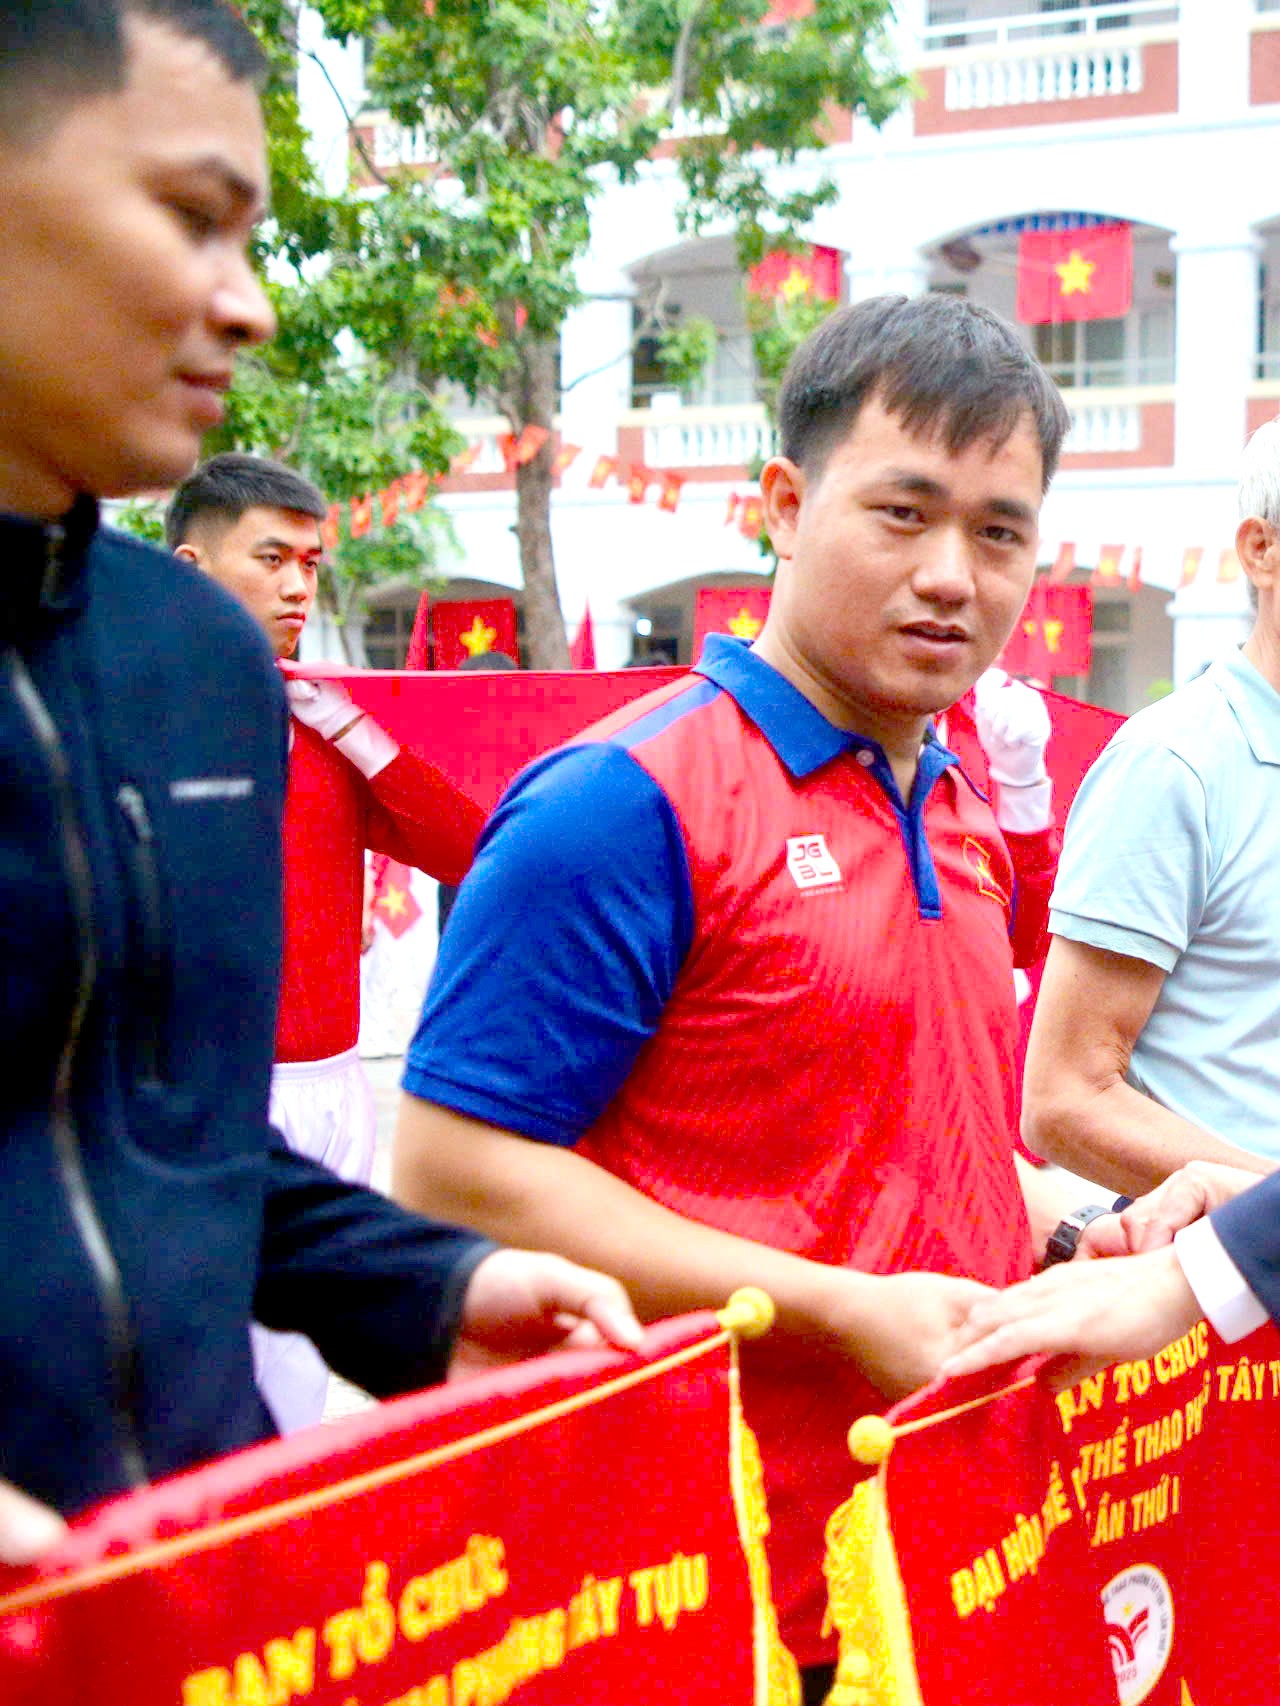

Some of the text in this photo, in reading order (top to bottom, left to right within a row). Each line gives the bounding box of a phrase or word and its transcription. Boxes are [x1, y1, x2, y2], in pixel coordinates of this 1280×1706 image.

[951, 1548, 1006, 1619] ĐẠI
[1133, 1409, 1182, 1467] THAO
[1216, 1356, 1265, 1401] TÂY
[323, 1561, 396, 1679] TỔ
[629, 1552, 707, 1631] TỰU
